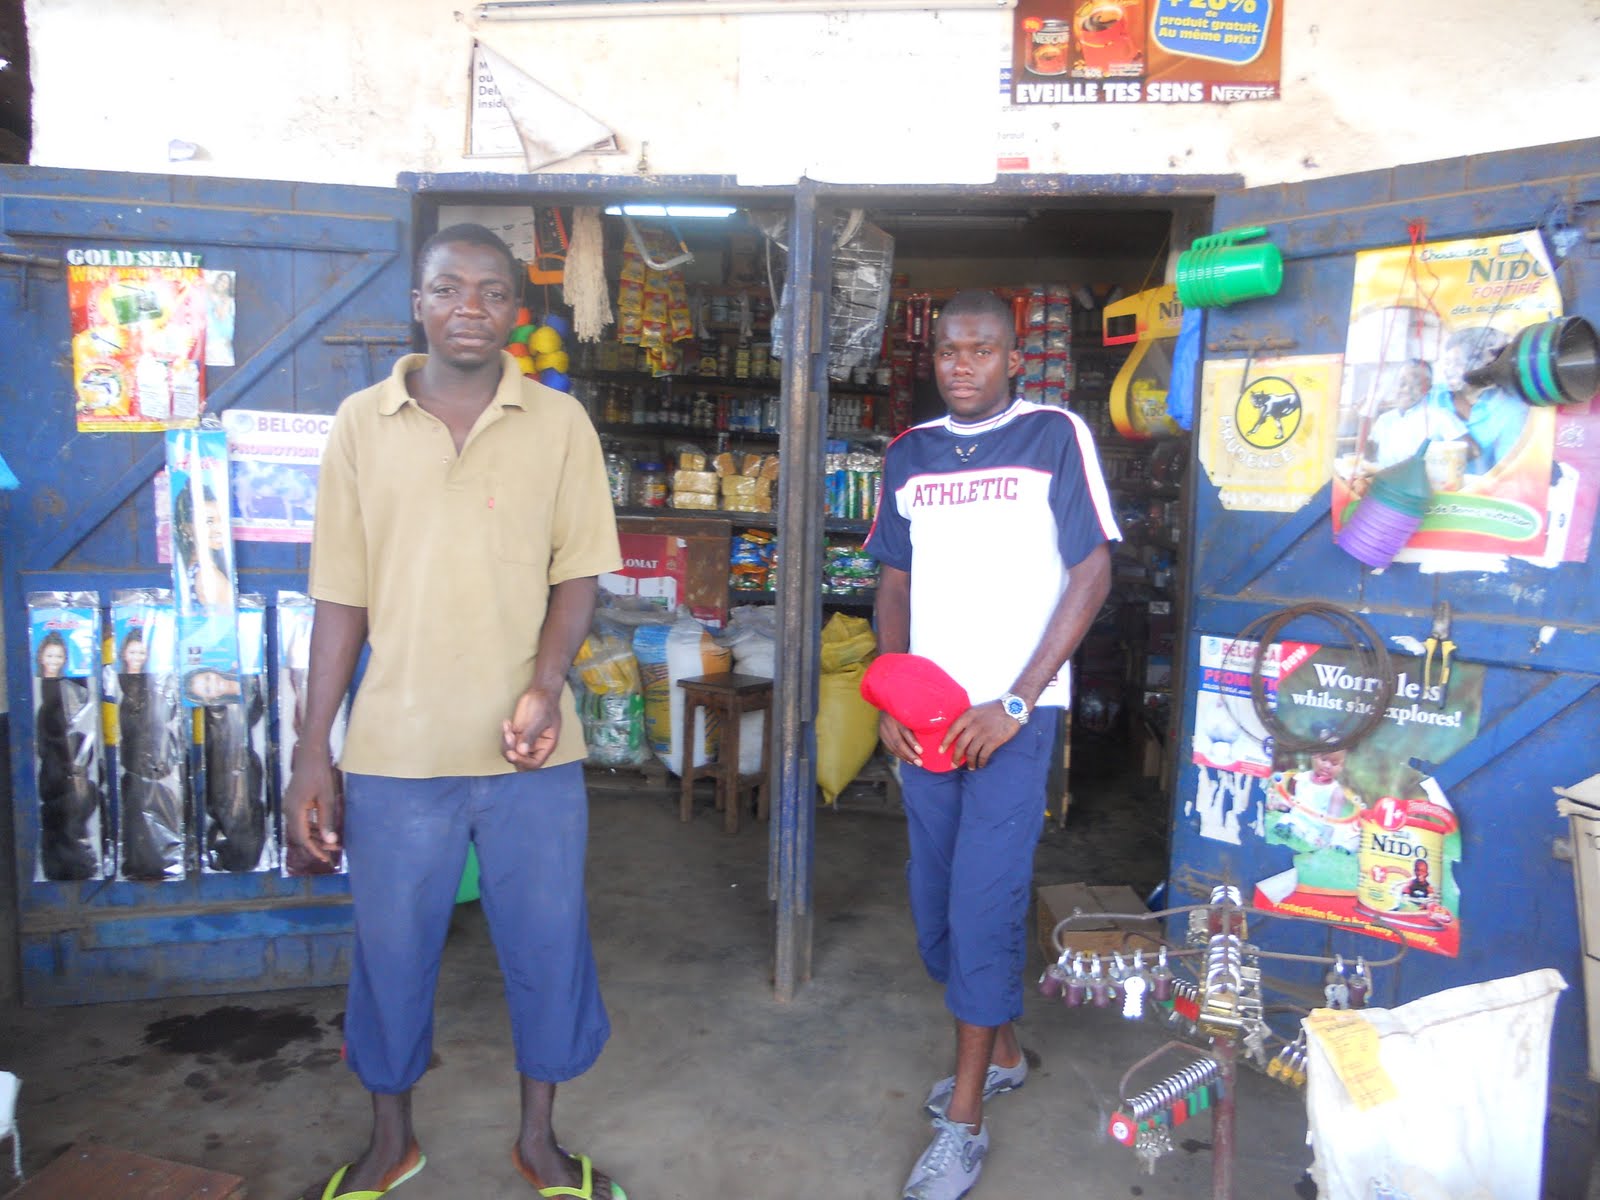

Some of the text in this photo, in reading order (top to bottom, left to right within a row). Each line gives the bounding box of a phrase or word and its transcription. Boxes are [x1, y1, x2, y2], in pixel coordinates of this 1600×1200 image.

[1160, 16, 1208, 28] produit
[1159, 27, 1257, 44] Au même prix!
[479, 86, 502, 96] Del
[1016, 84, 1099, 103] EVEILLE
[1102, 82, 1141, 102] TES
[1146, 83, 1203, 102] SENS
[67, 249, 202, 268] GOLD SEAL
[1472, 280, 1541, 299] FORTIFIÉ
[258, 416, 329, 435] BELGOC
[912, 476, 1018, 507] ATHLETIC
[624, 558, 659, 569] OMAT
[1281, 645, 1308, 671] new
[1291, 690, 1343, 711] whilst
[1381, 801, 1403, 827] 1+
[1370, 833, 1428, 859] NIDO
